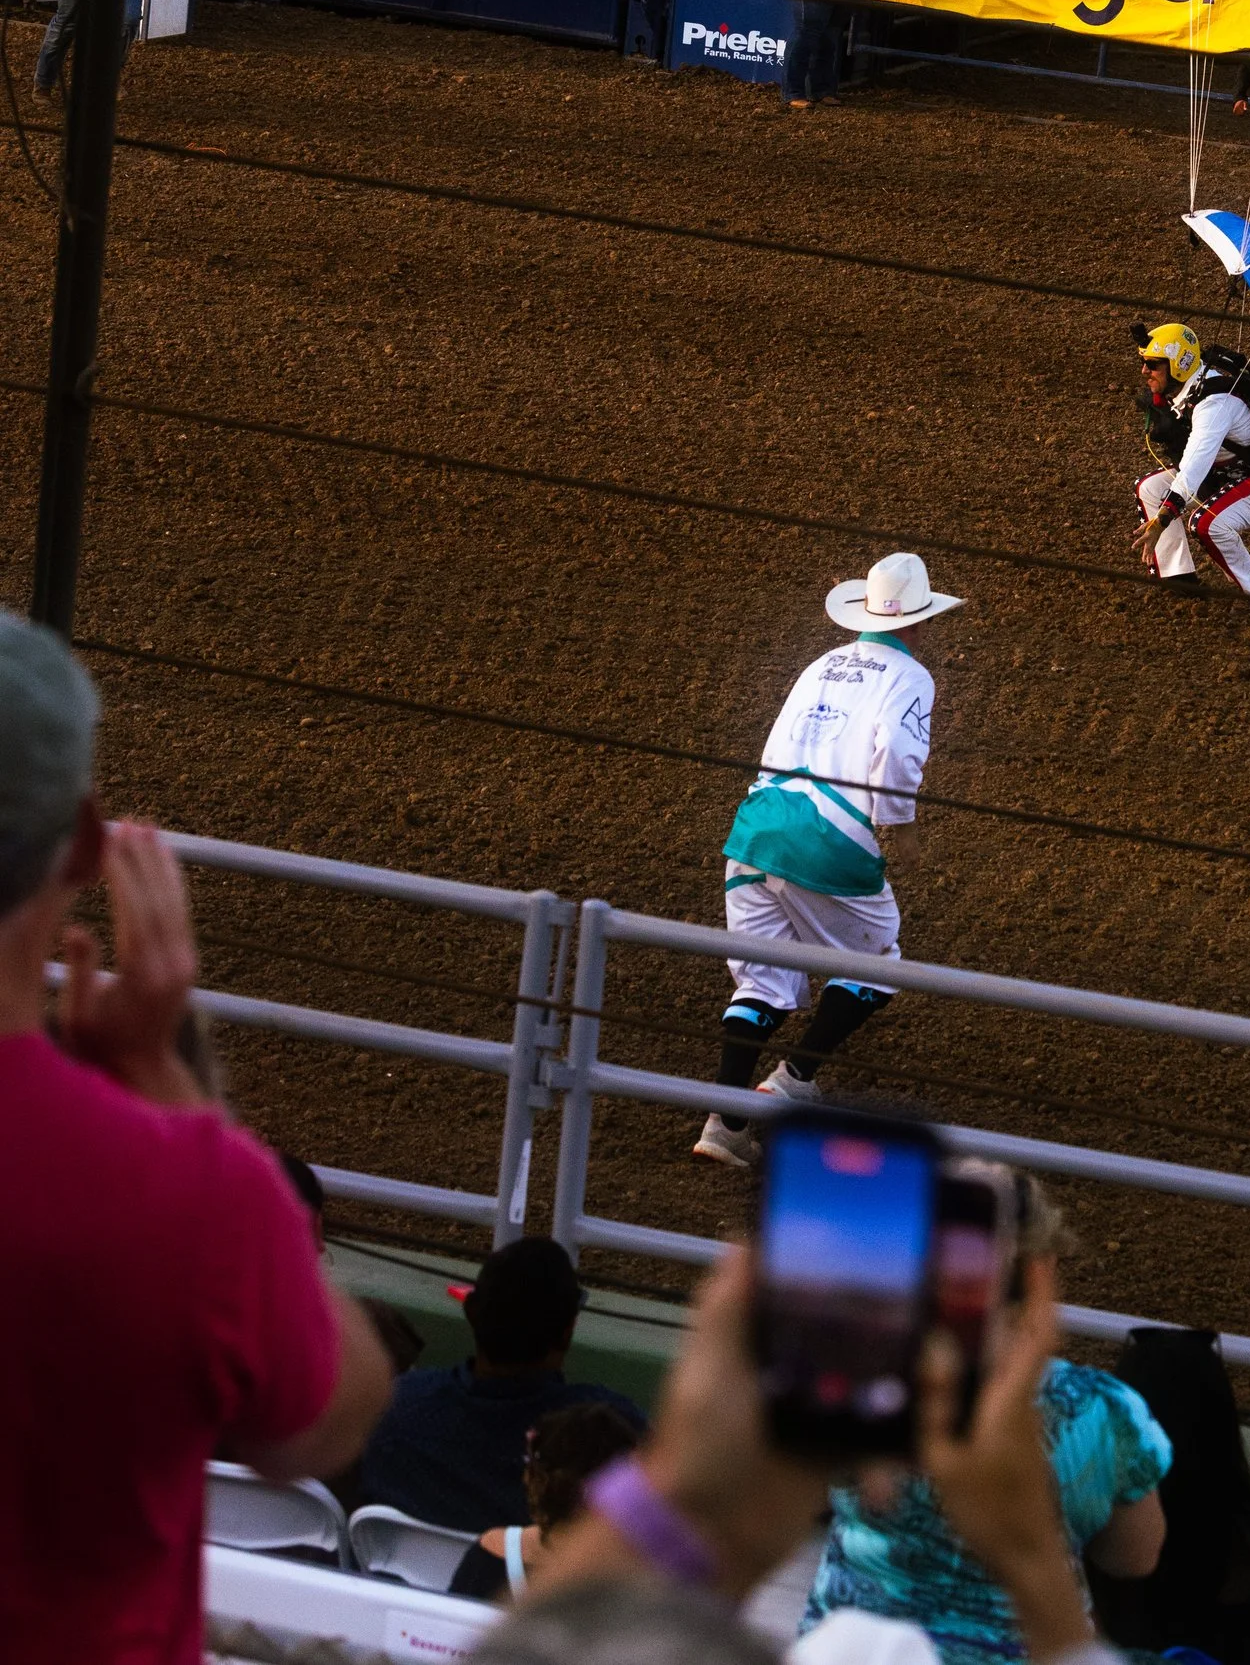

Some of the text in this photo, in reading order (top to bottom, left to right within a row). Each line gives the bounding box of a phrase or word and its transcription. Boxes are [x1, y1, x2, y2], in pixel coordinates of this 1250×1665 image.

[682, 21, 787, 58] Priefer
[703, 48, 731, 61] Farm,
[733, 51, 763, 63] Ranch
